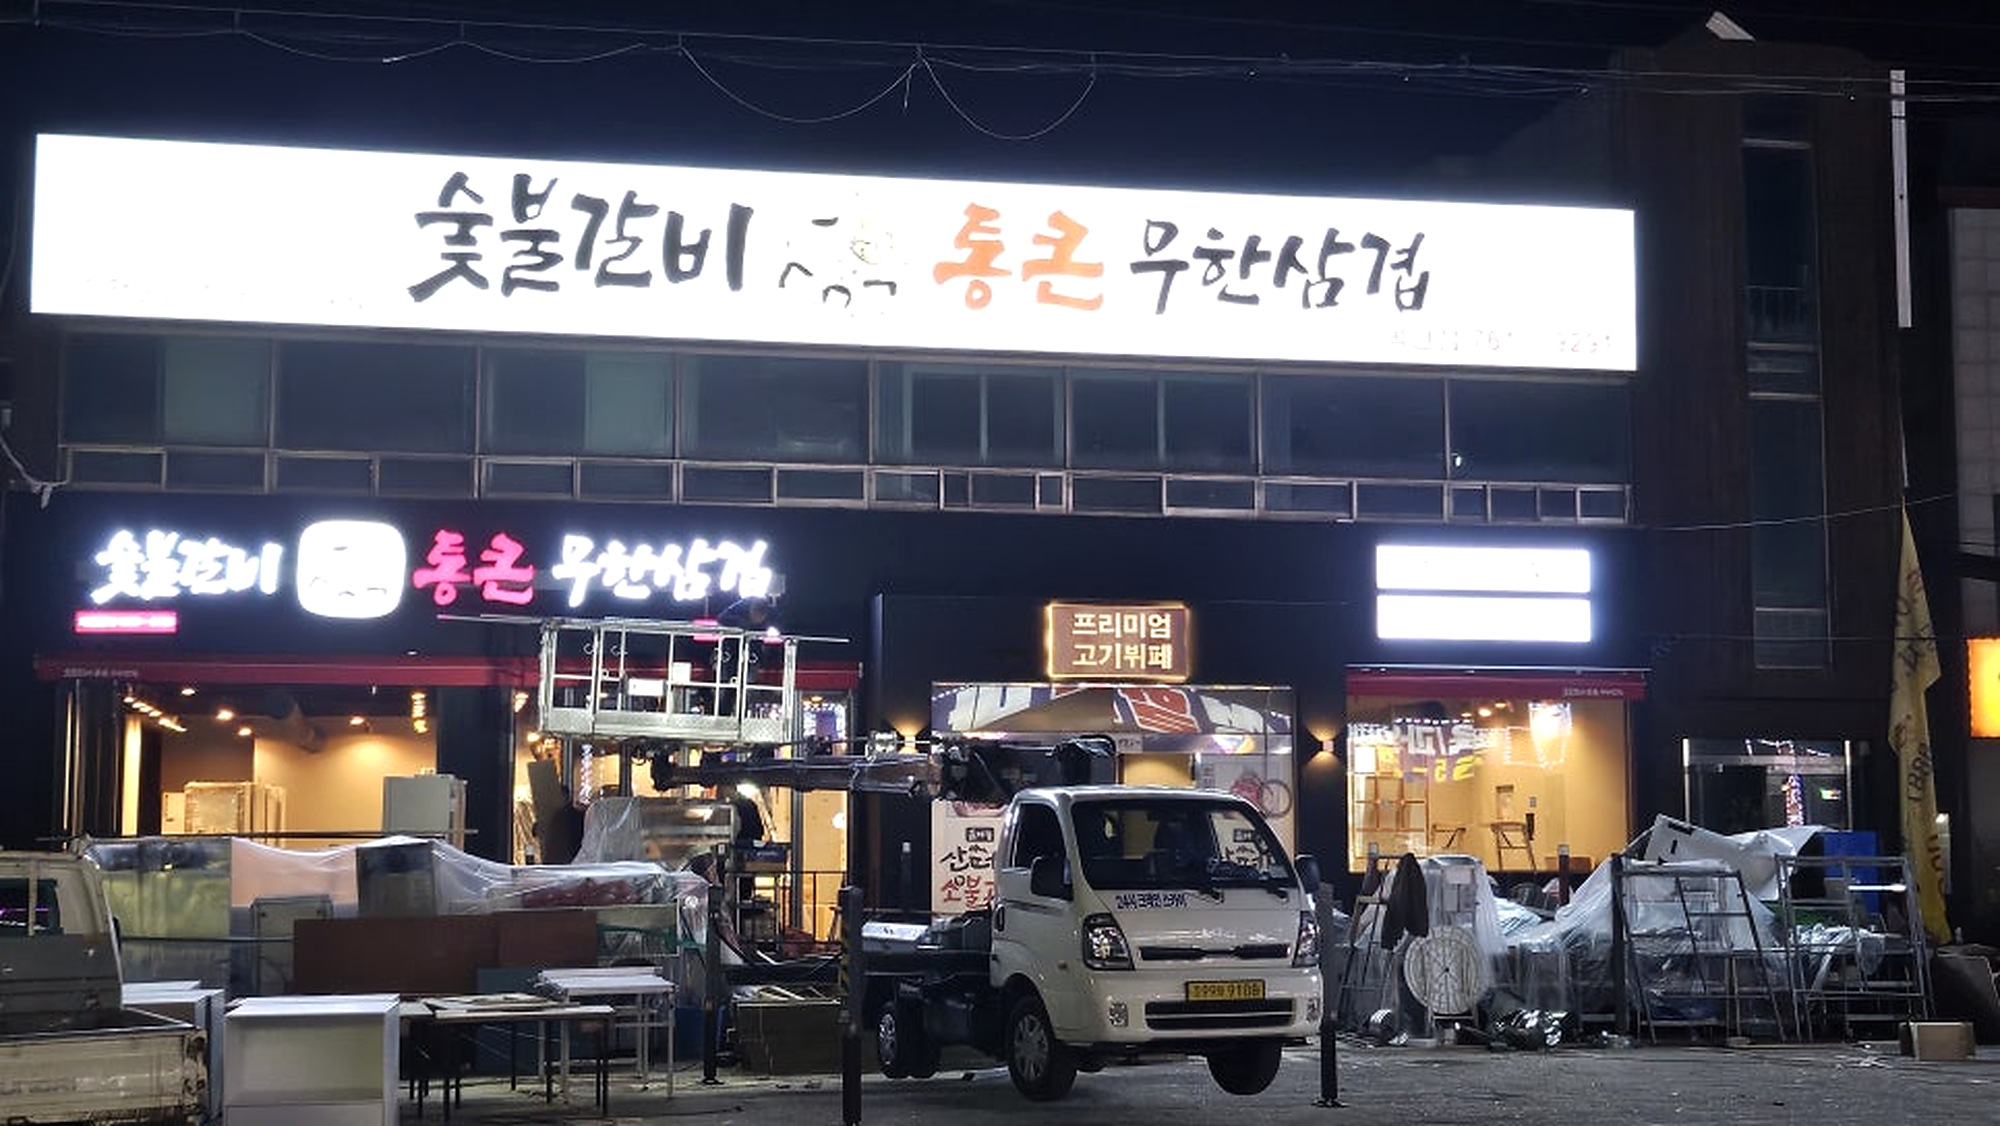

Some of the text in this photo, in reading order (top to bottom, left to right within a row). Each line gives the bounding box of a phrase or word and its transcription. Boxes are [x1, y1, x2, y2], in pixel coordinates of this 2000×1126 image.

[408, 171, 1430, 314] 숯불갈비 통큰 무한삼겹
[91, 528, 773, 608] 숯불갈비 통큰 무한삼겹
[1071, 610, 1172, 639] 프리미엄
[1071, 641, 1174, 671] 고기뷔페
